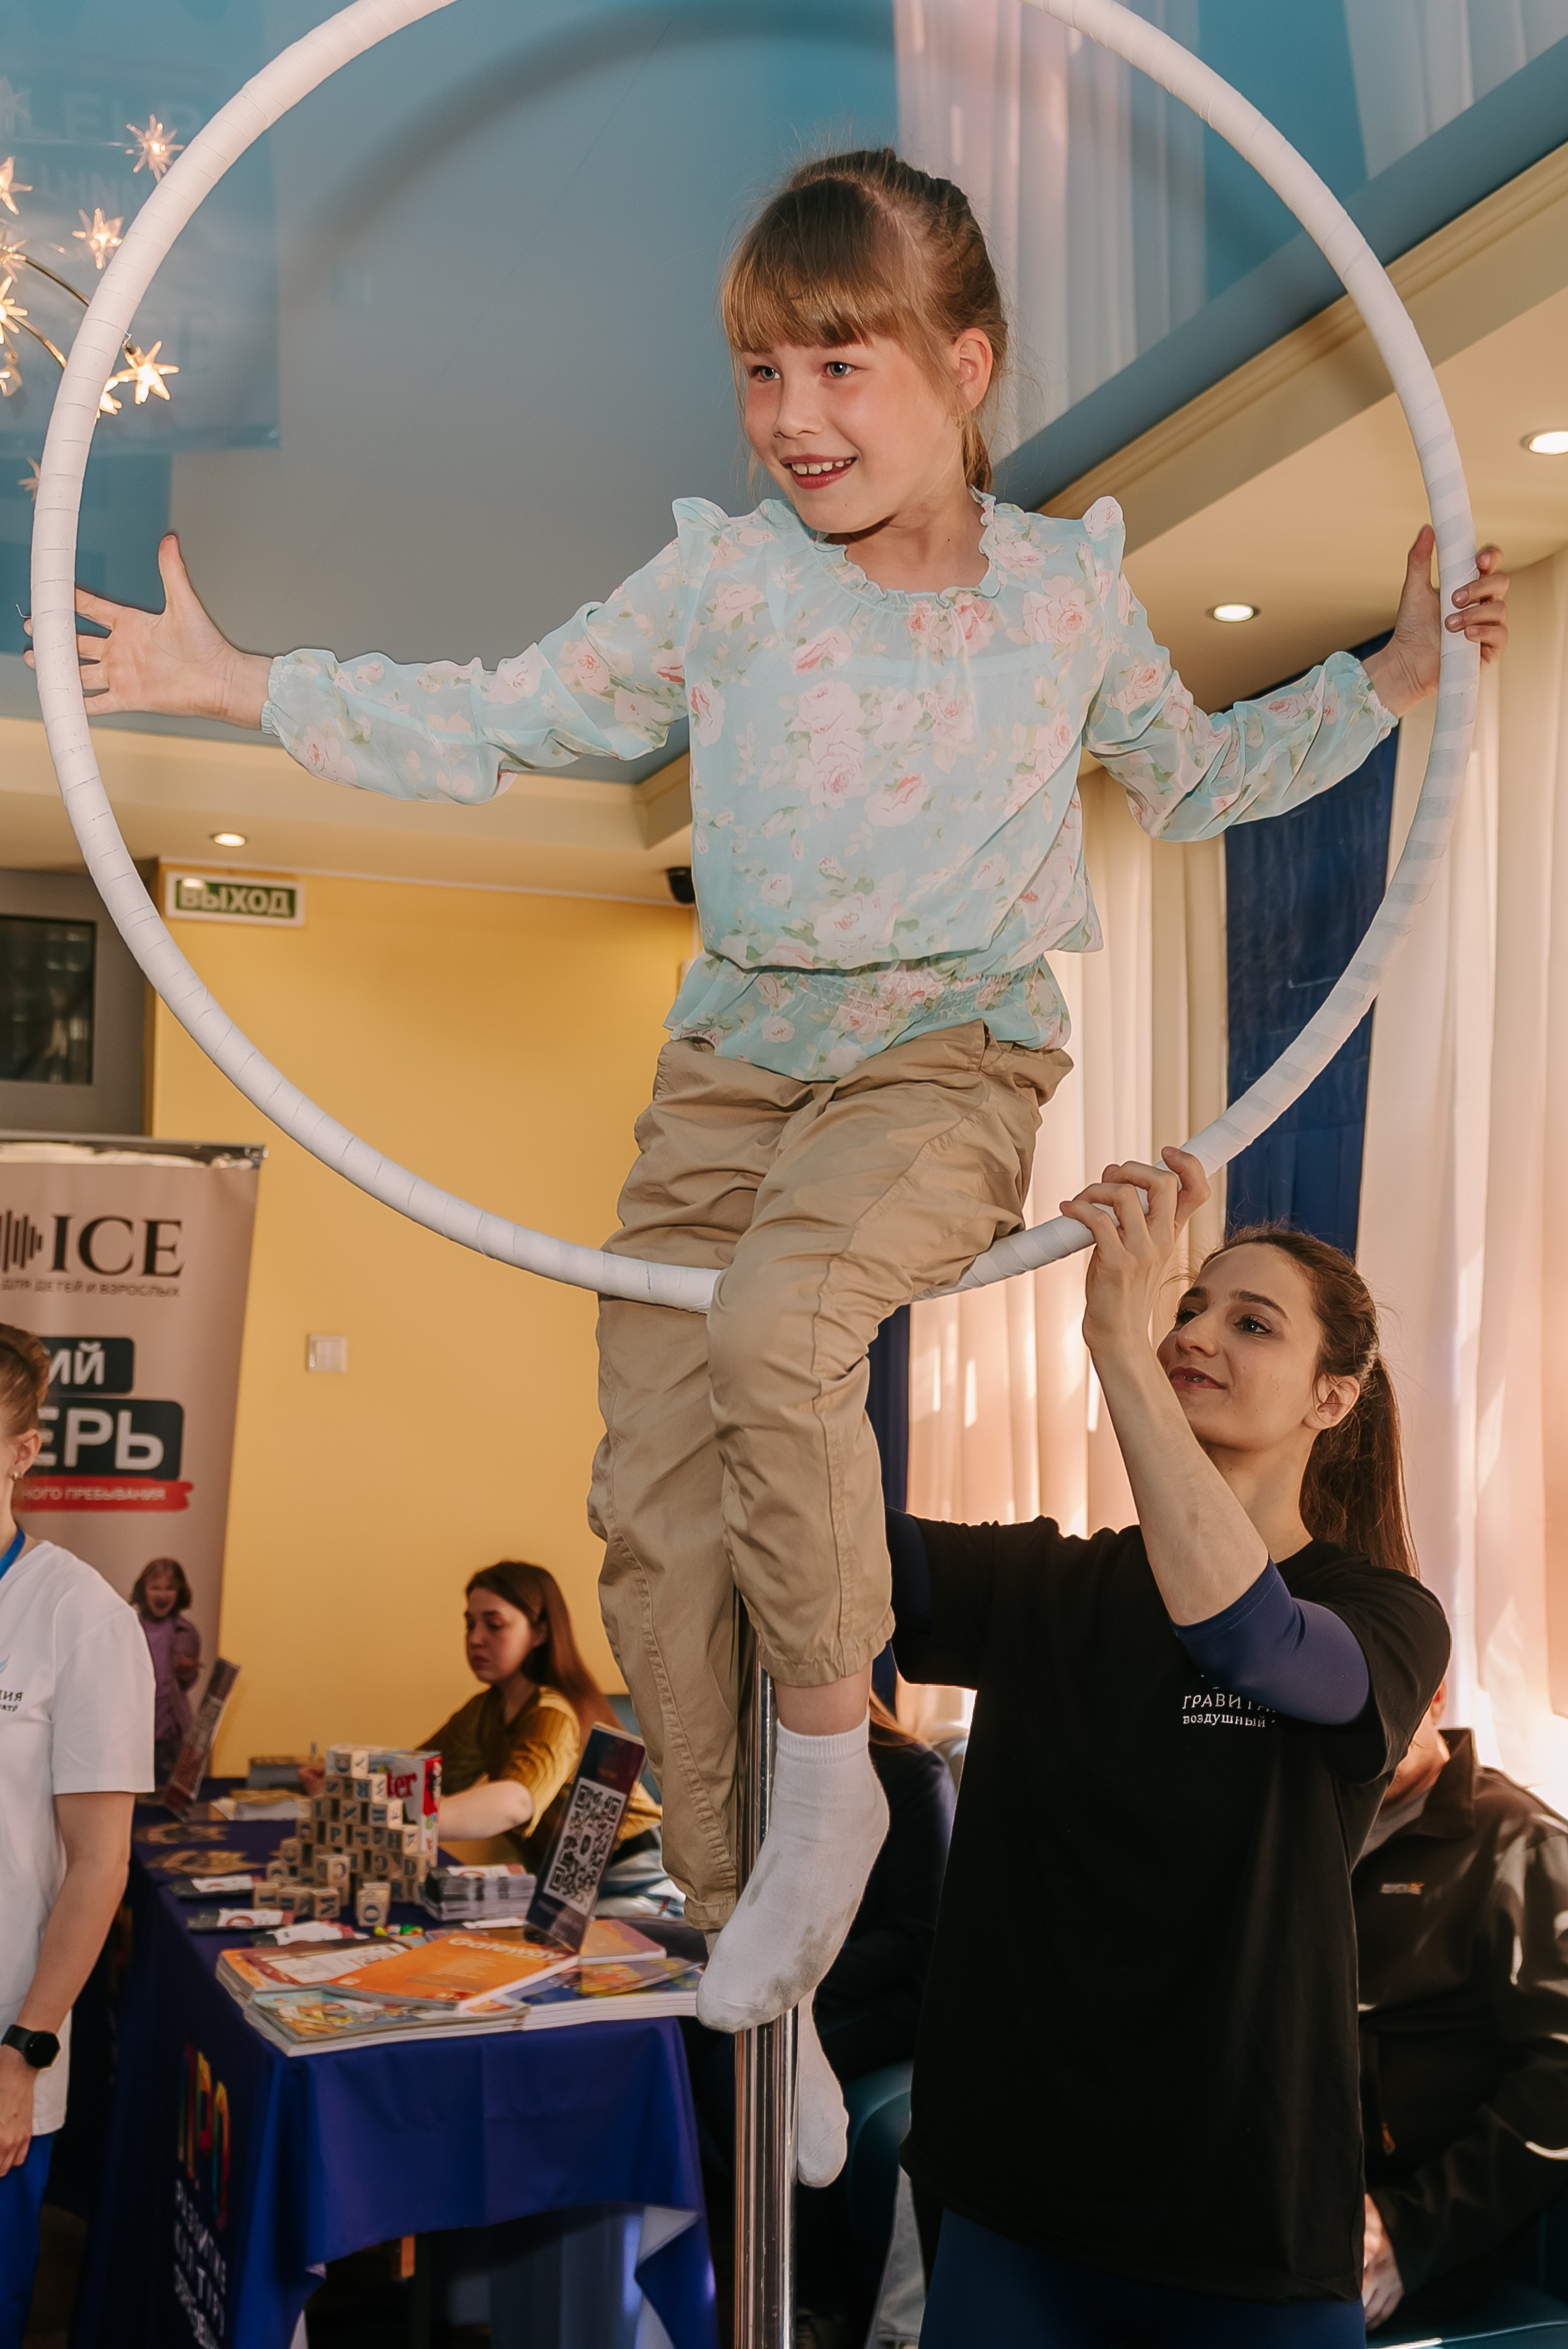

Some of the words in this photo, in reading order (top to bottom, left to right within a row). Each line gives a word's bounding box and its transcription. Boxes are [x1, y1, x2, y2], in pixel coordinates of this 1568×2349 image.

[179, 884, 290, 916] ВЫХОД
[34, 1279, 83, 1293] ДЕТЕЙ
[85, 1282, 96, 1294] И
[98, 1282, 181, 1298] ВЗРОСЛЫХ
[64, 1485, 167, 1502] ПРЕБЫВАНИЯ
